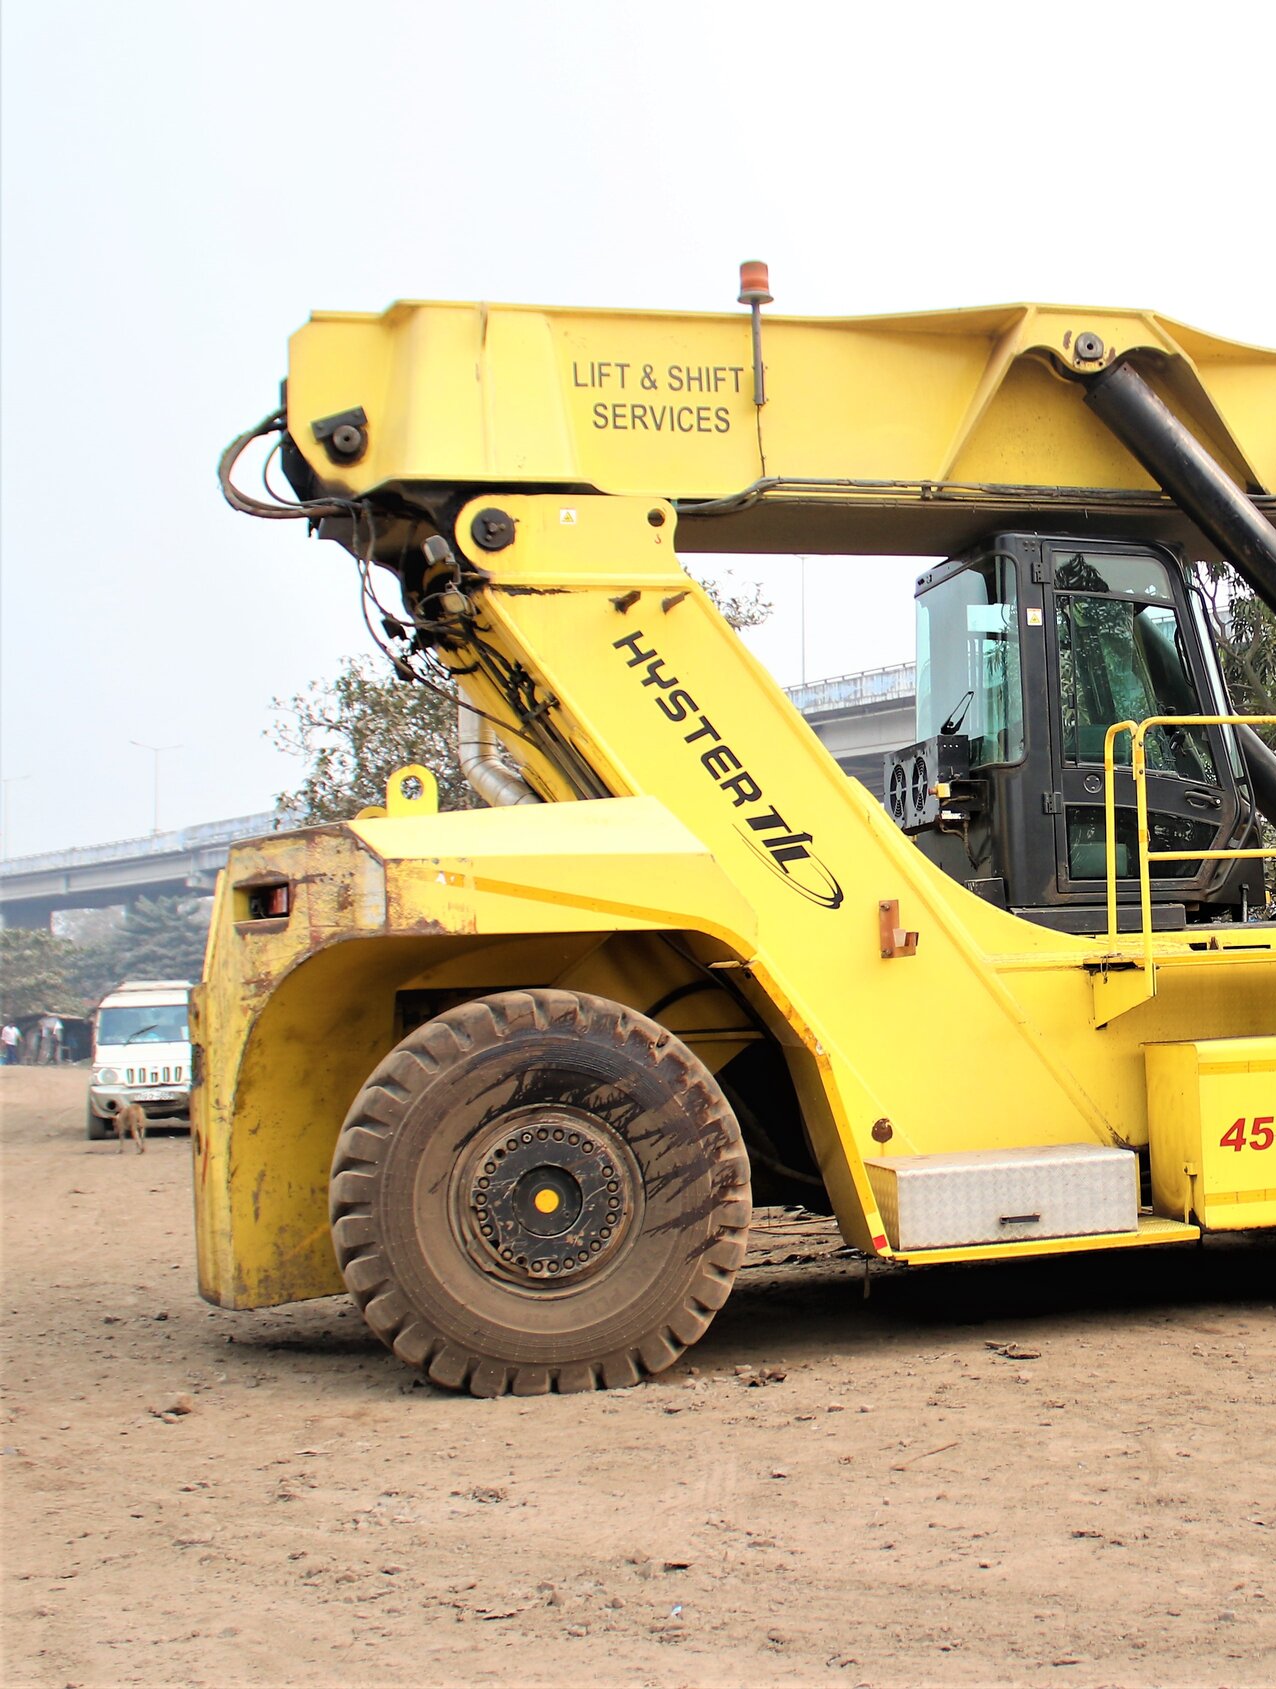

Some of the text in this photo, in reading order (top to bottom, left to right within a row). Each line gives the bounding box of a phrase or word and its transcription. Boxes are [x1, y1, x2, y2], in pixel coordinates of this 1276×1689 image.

[572, 361, 745, 393] LIFT & SHIFT
[592, 403, 731, 433] SERVICES
[612, 630, 763, 808] HYSTER
